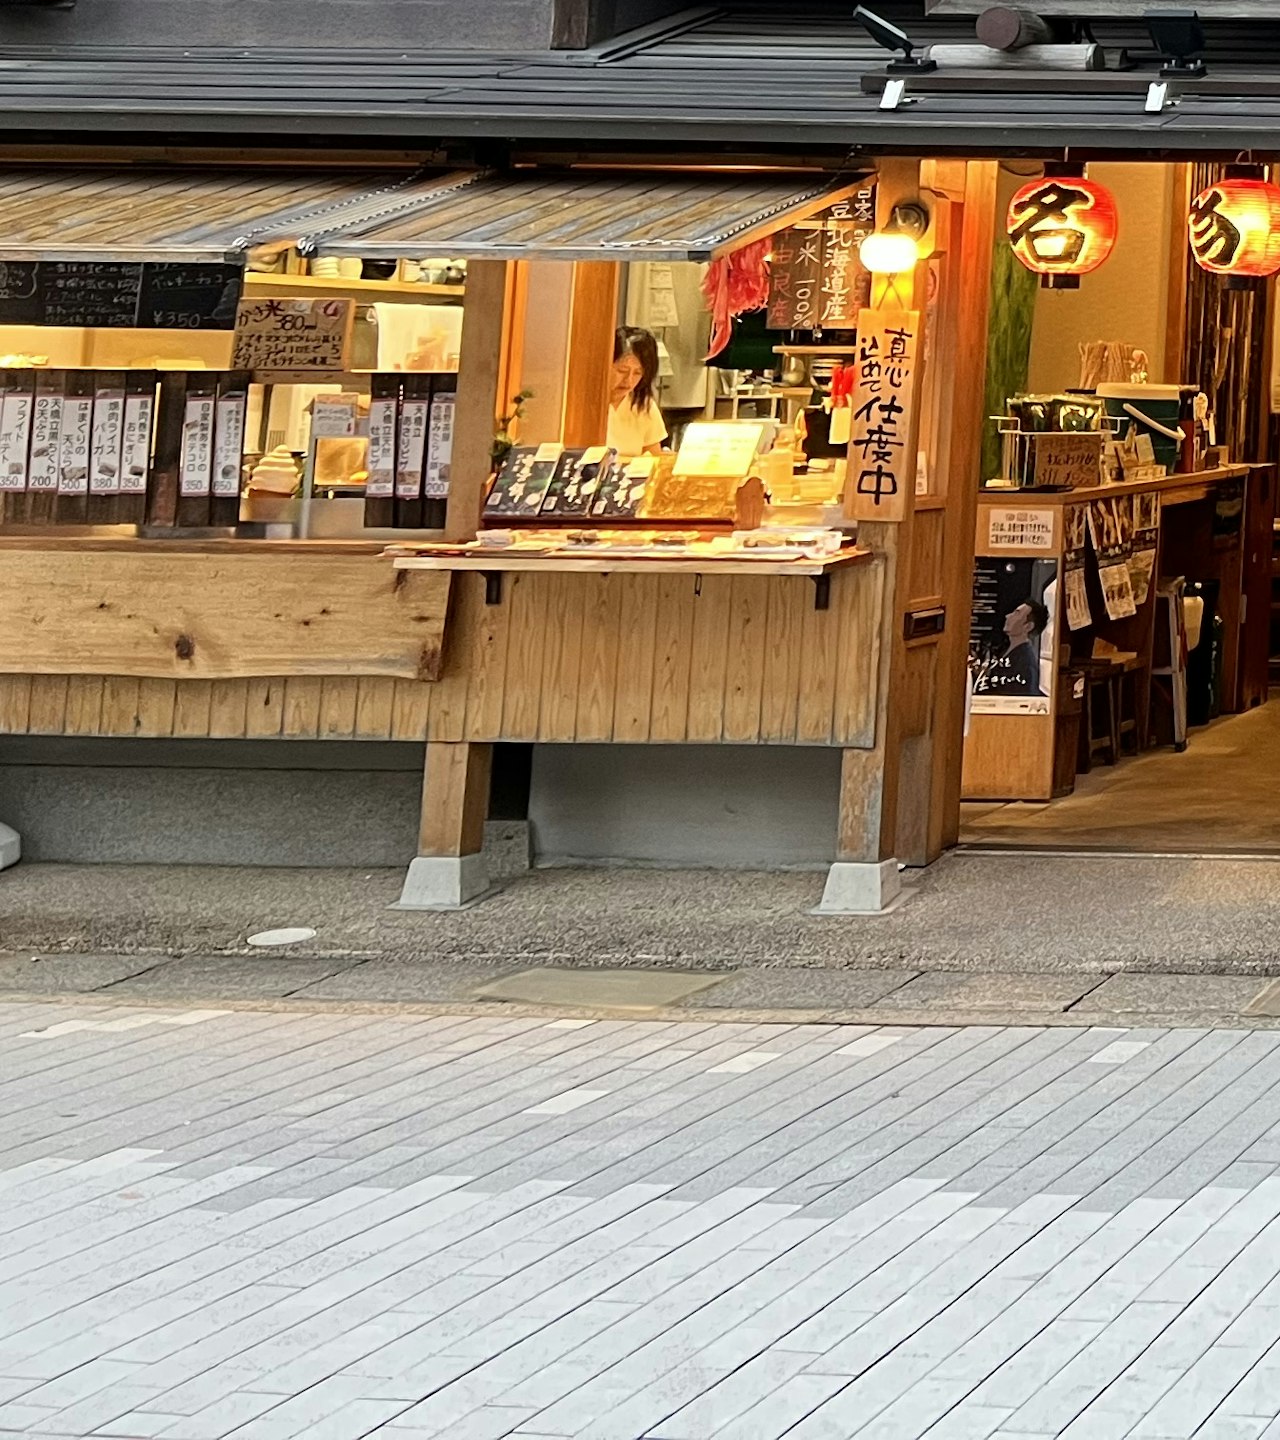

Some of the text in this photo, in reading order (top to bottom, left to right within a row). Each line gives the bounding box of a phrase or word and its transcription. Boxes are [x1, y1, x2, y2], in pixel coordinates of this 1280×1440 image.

[1008, 183, 1094, 265] 名
[860, 335, 882, 393] 込めて
[884, 327, 913, 388] 真心
[15, 399, 28, 442] フライド
[853, 394, 905, 506] 仕度中
[31, 475, 51, 487] 200
[61, 480, 80, 490] 500
